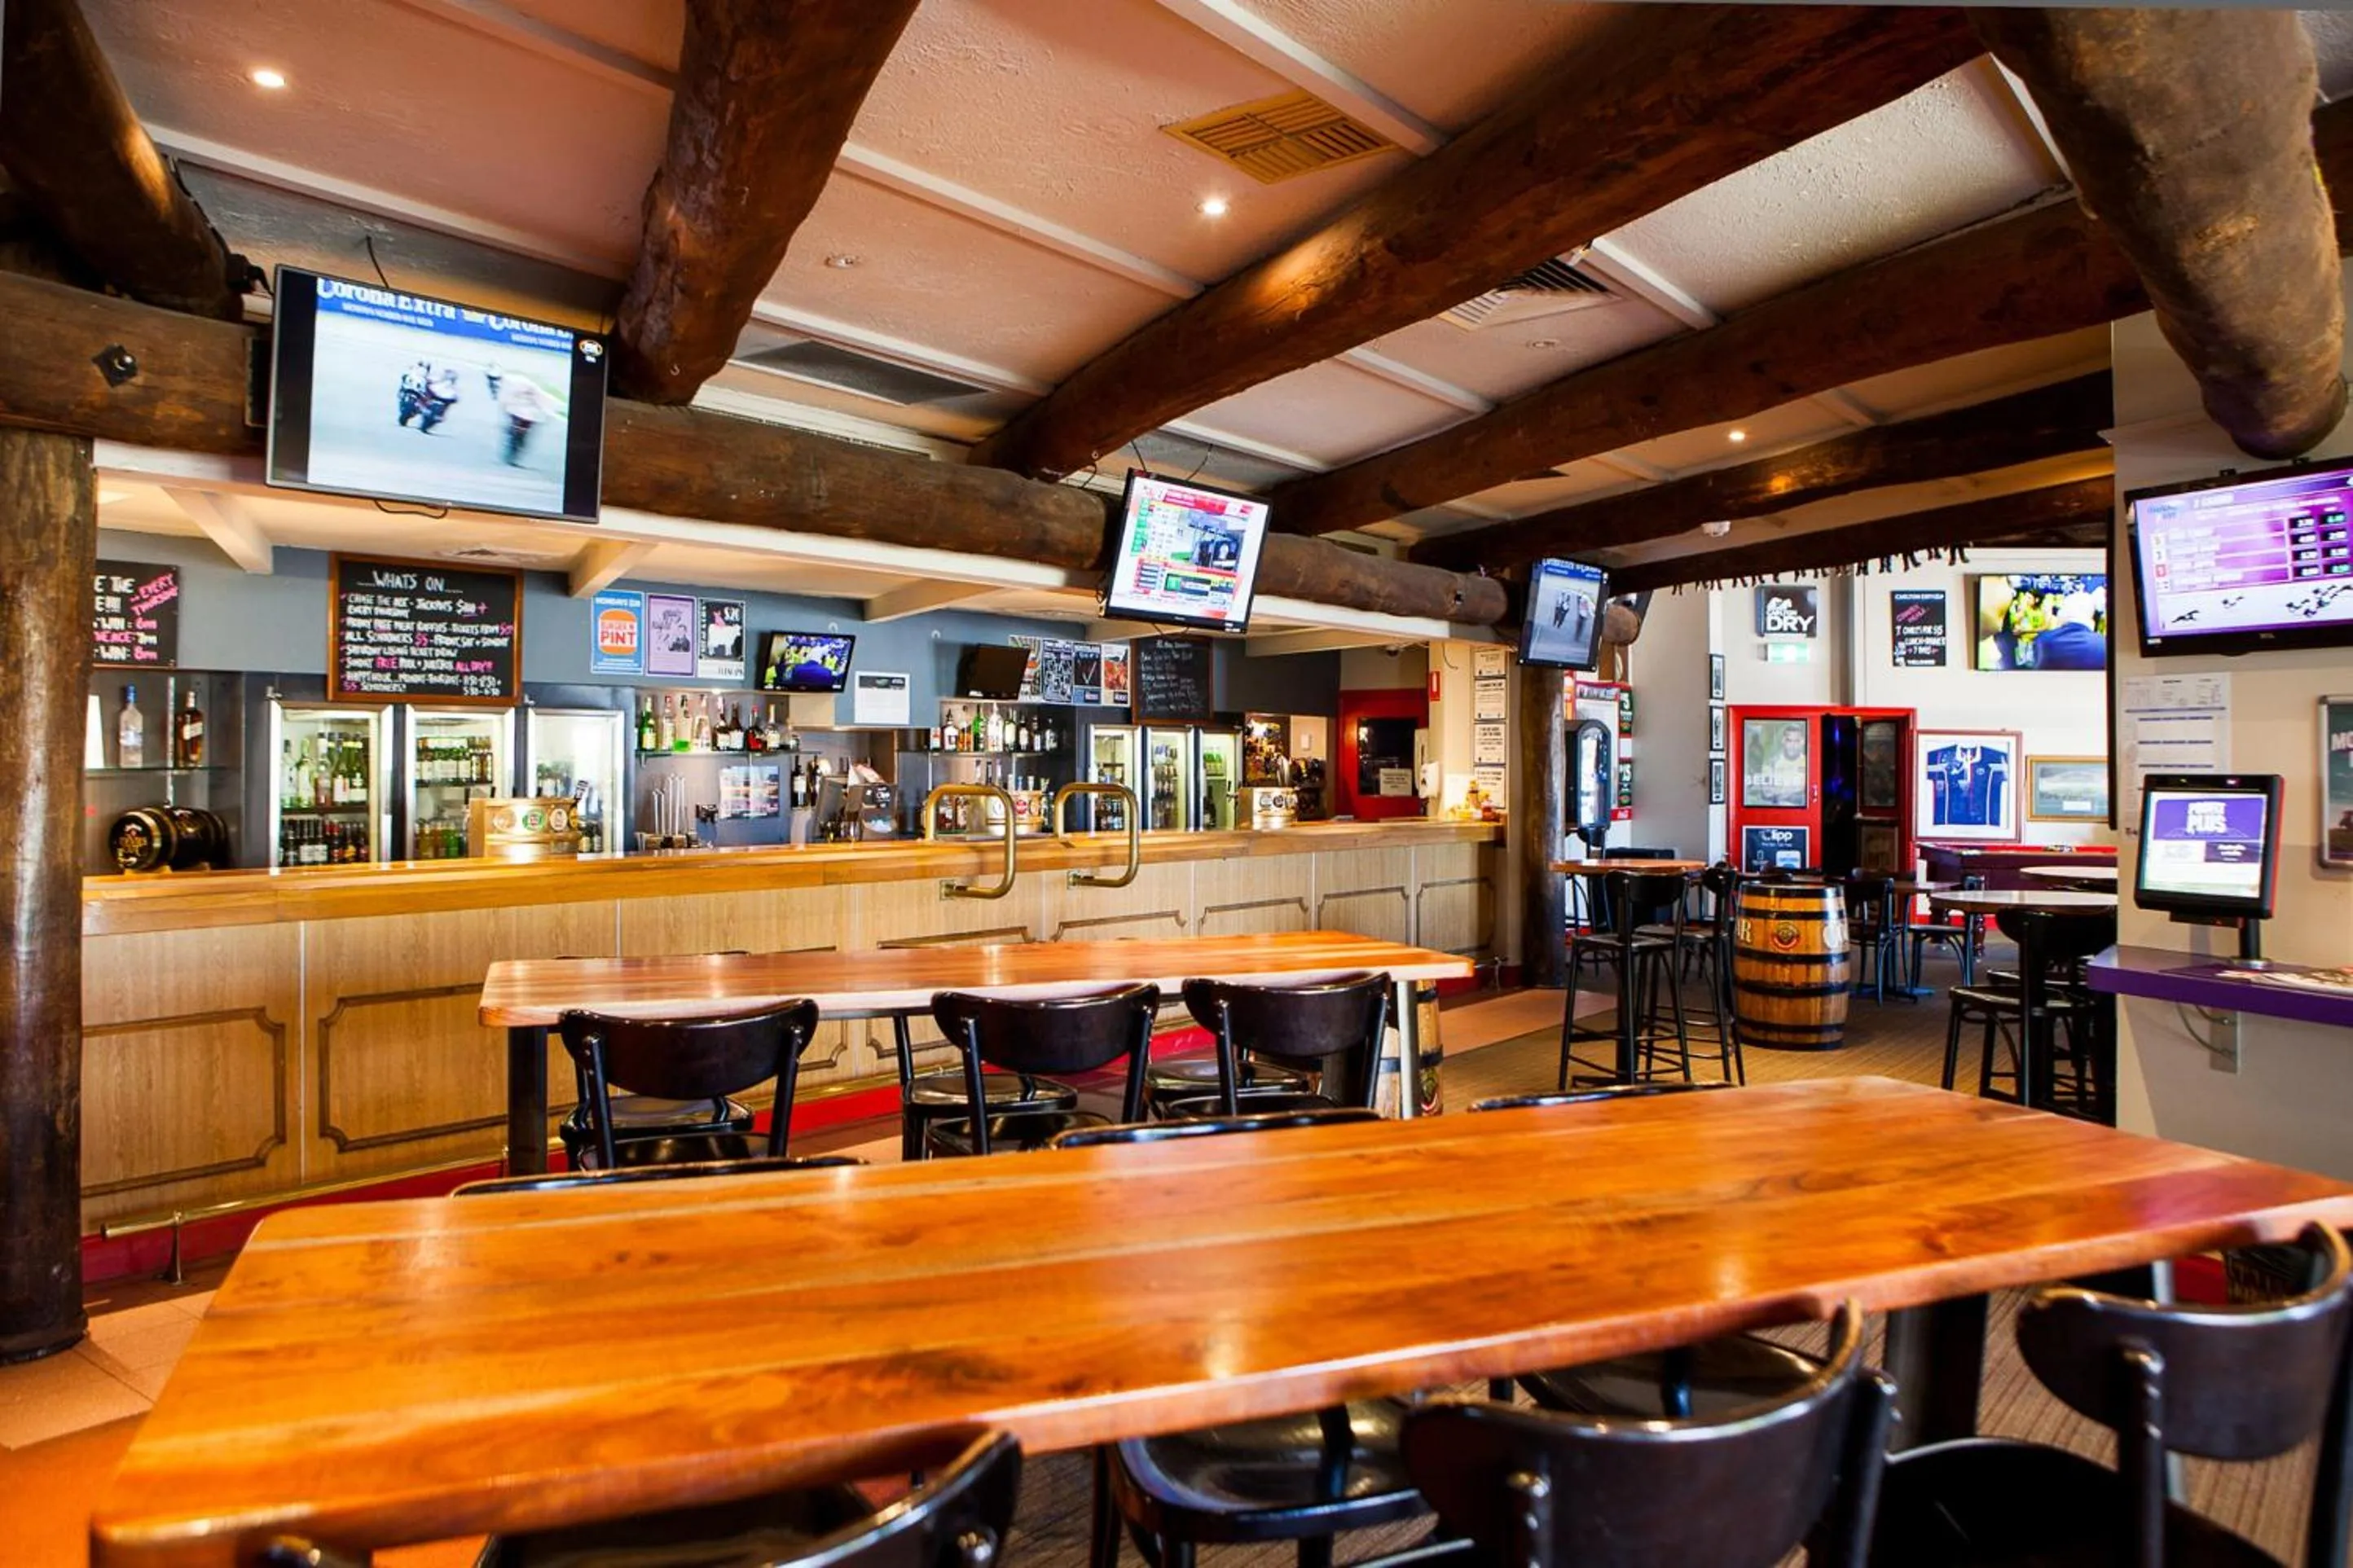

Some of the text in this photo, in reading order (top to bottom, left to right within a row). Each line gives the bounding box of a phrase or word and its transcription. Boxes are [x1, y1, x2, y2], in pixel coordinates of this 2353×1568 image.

[425, 577, 446, 592] ON
[1766, 615, 1815, 631] DRY
[600, 630, 636, 646] PINT
